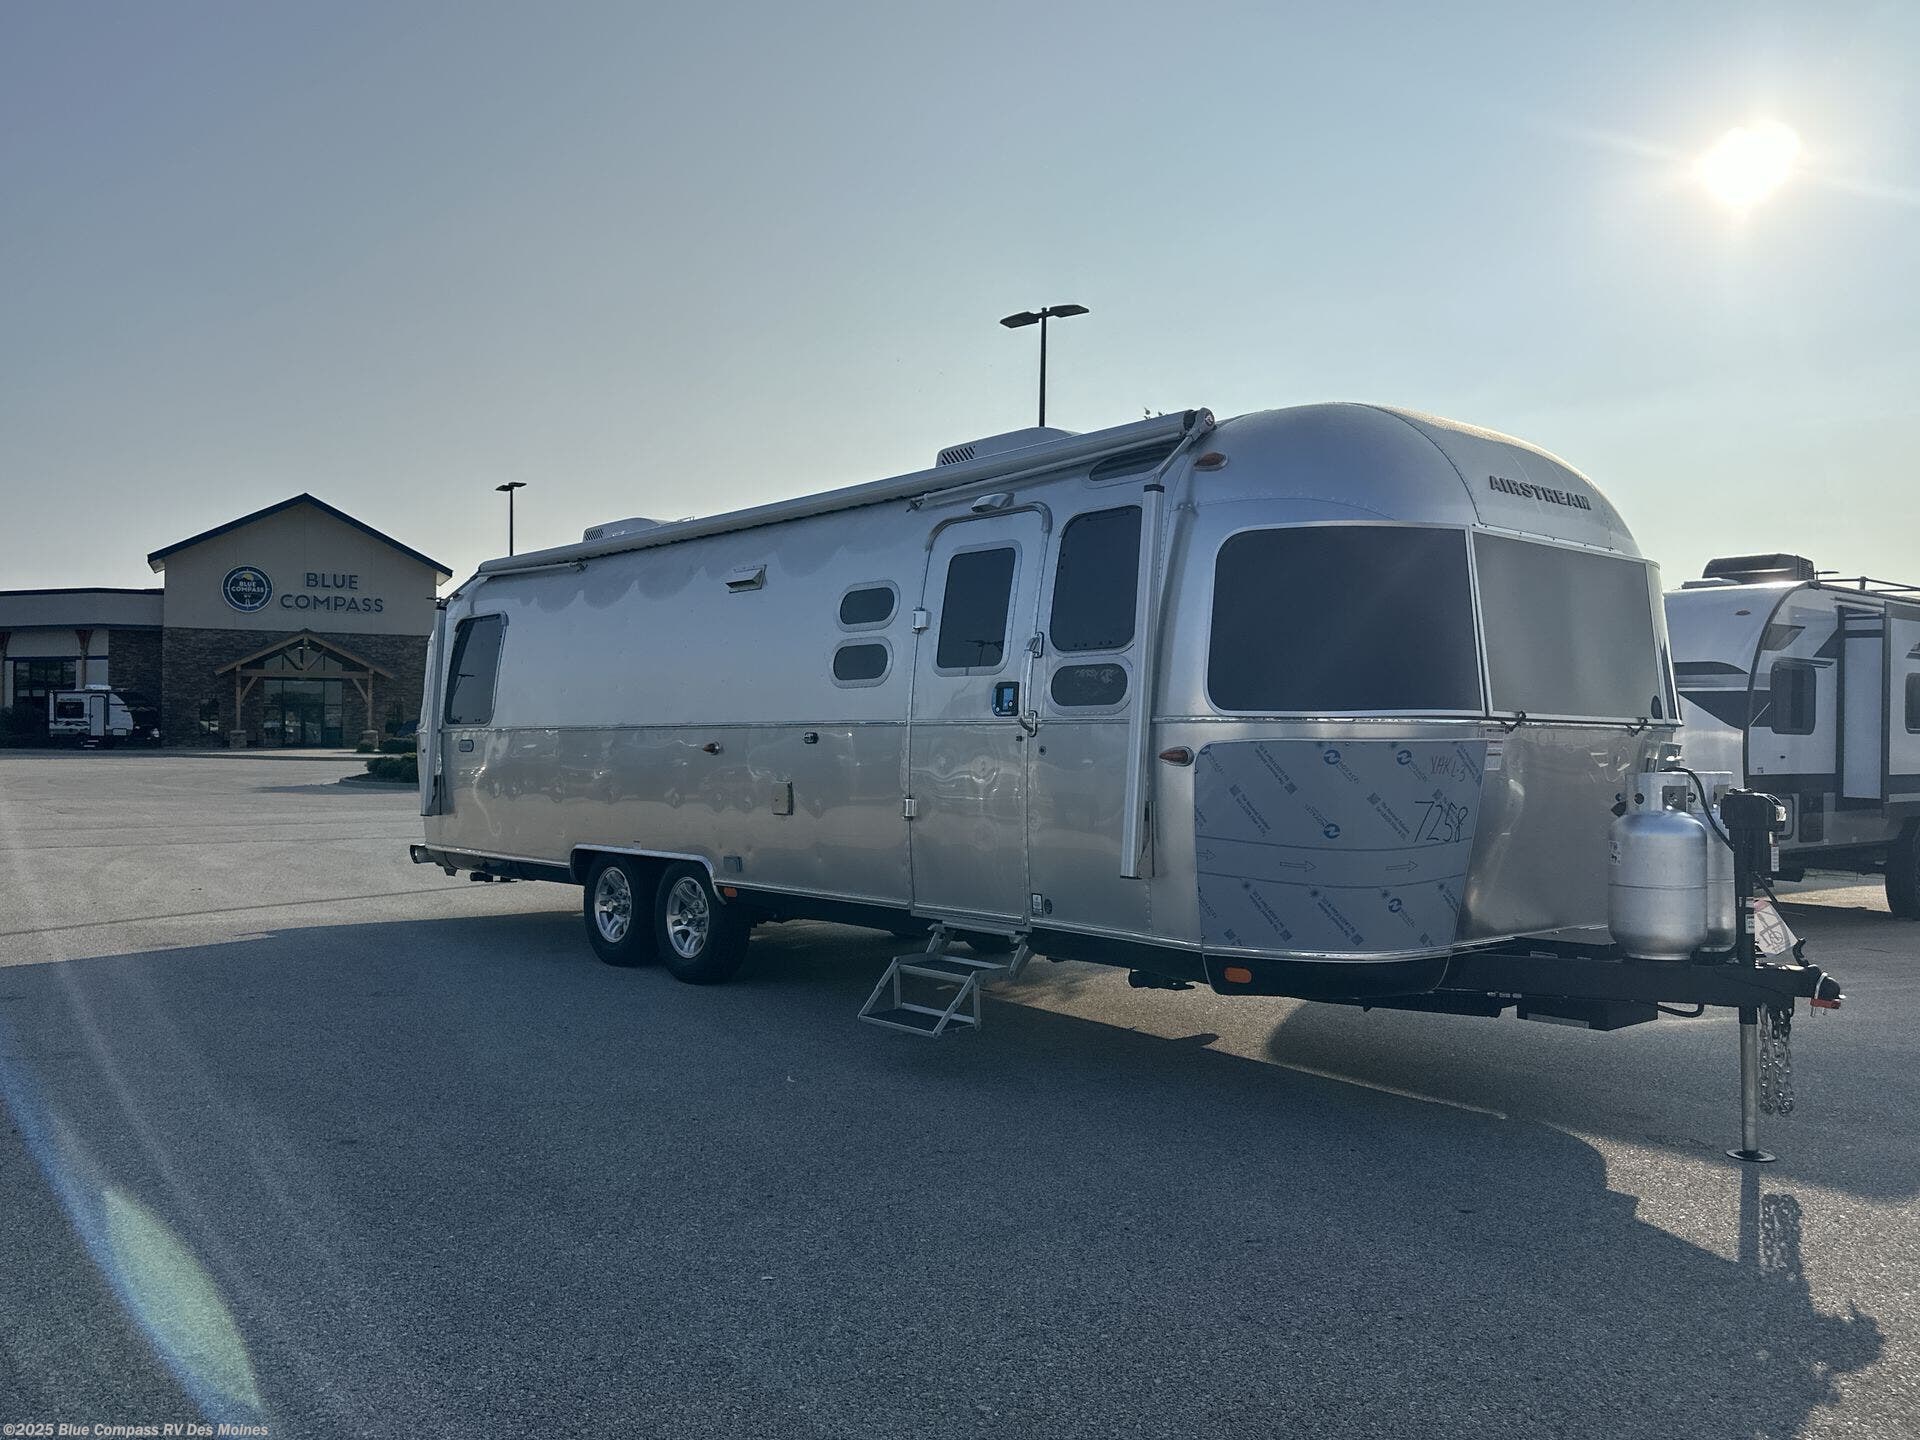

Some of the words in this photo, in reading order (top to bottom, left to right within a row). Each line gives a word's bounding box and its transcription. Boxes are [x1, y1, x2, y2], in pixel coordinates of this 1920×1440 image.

[1489, 475, 1592, 511] AIRSTREAM
[305, 572, 359, 590] BLUE
[280, 594, 385, 613] COMPASS
[1413, 800, 1469, 843] 7258
